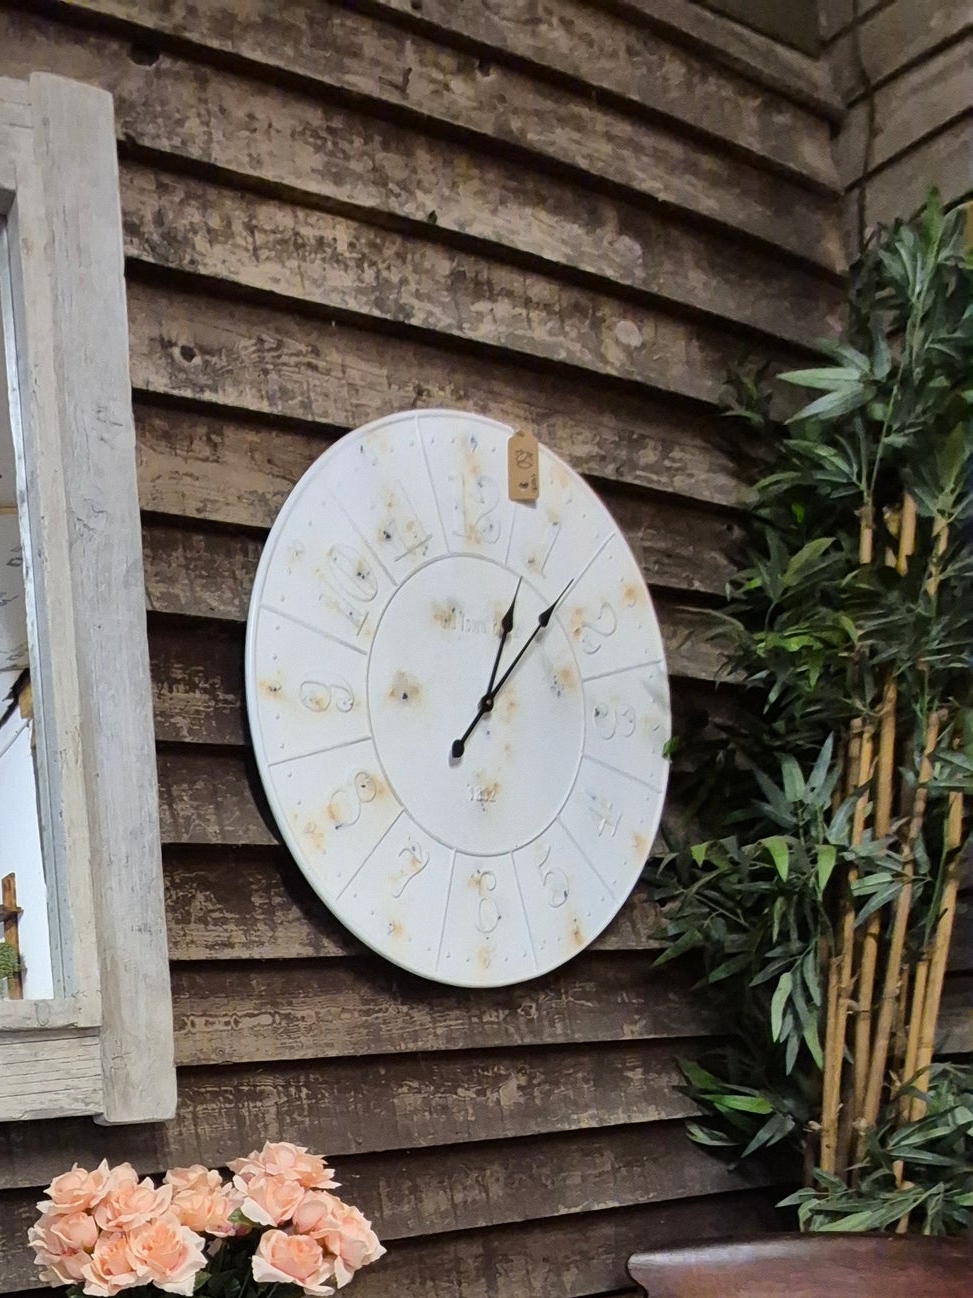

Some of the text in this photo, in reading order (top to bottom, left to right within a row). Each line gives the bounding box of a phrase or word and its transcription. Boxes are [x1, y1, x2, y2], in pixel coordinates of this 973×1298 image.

[449, 473, 501, 545] 12
[319, 543, 379, 637] 10
[574, 601, 617, 655] 2
[300, 675, 354, 713] 9
[593, 703, 635, 741] 3
[327, 771, 377, 829] 8
[585, 788, 623, 838] 4
[392, 840, 429, 898] 7
[539, 845, 570, 908] 5
[477, 870, 500, 933] 6
